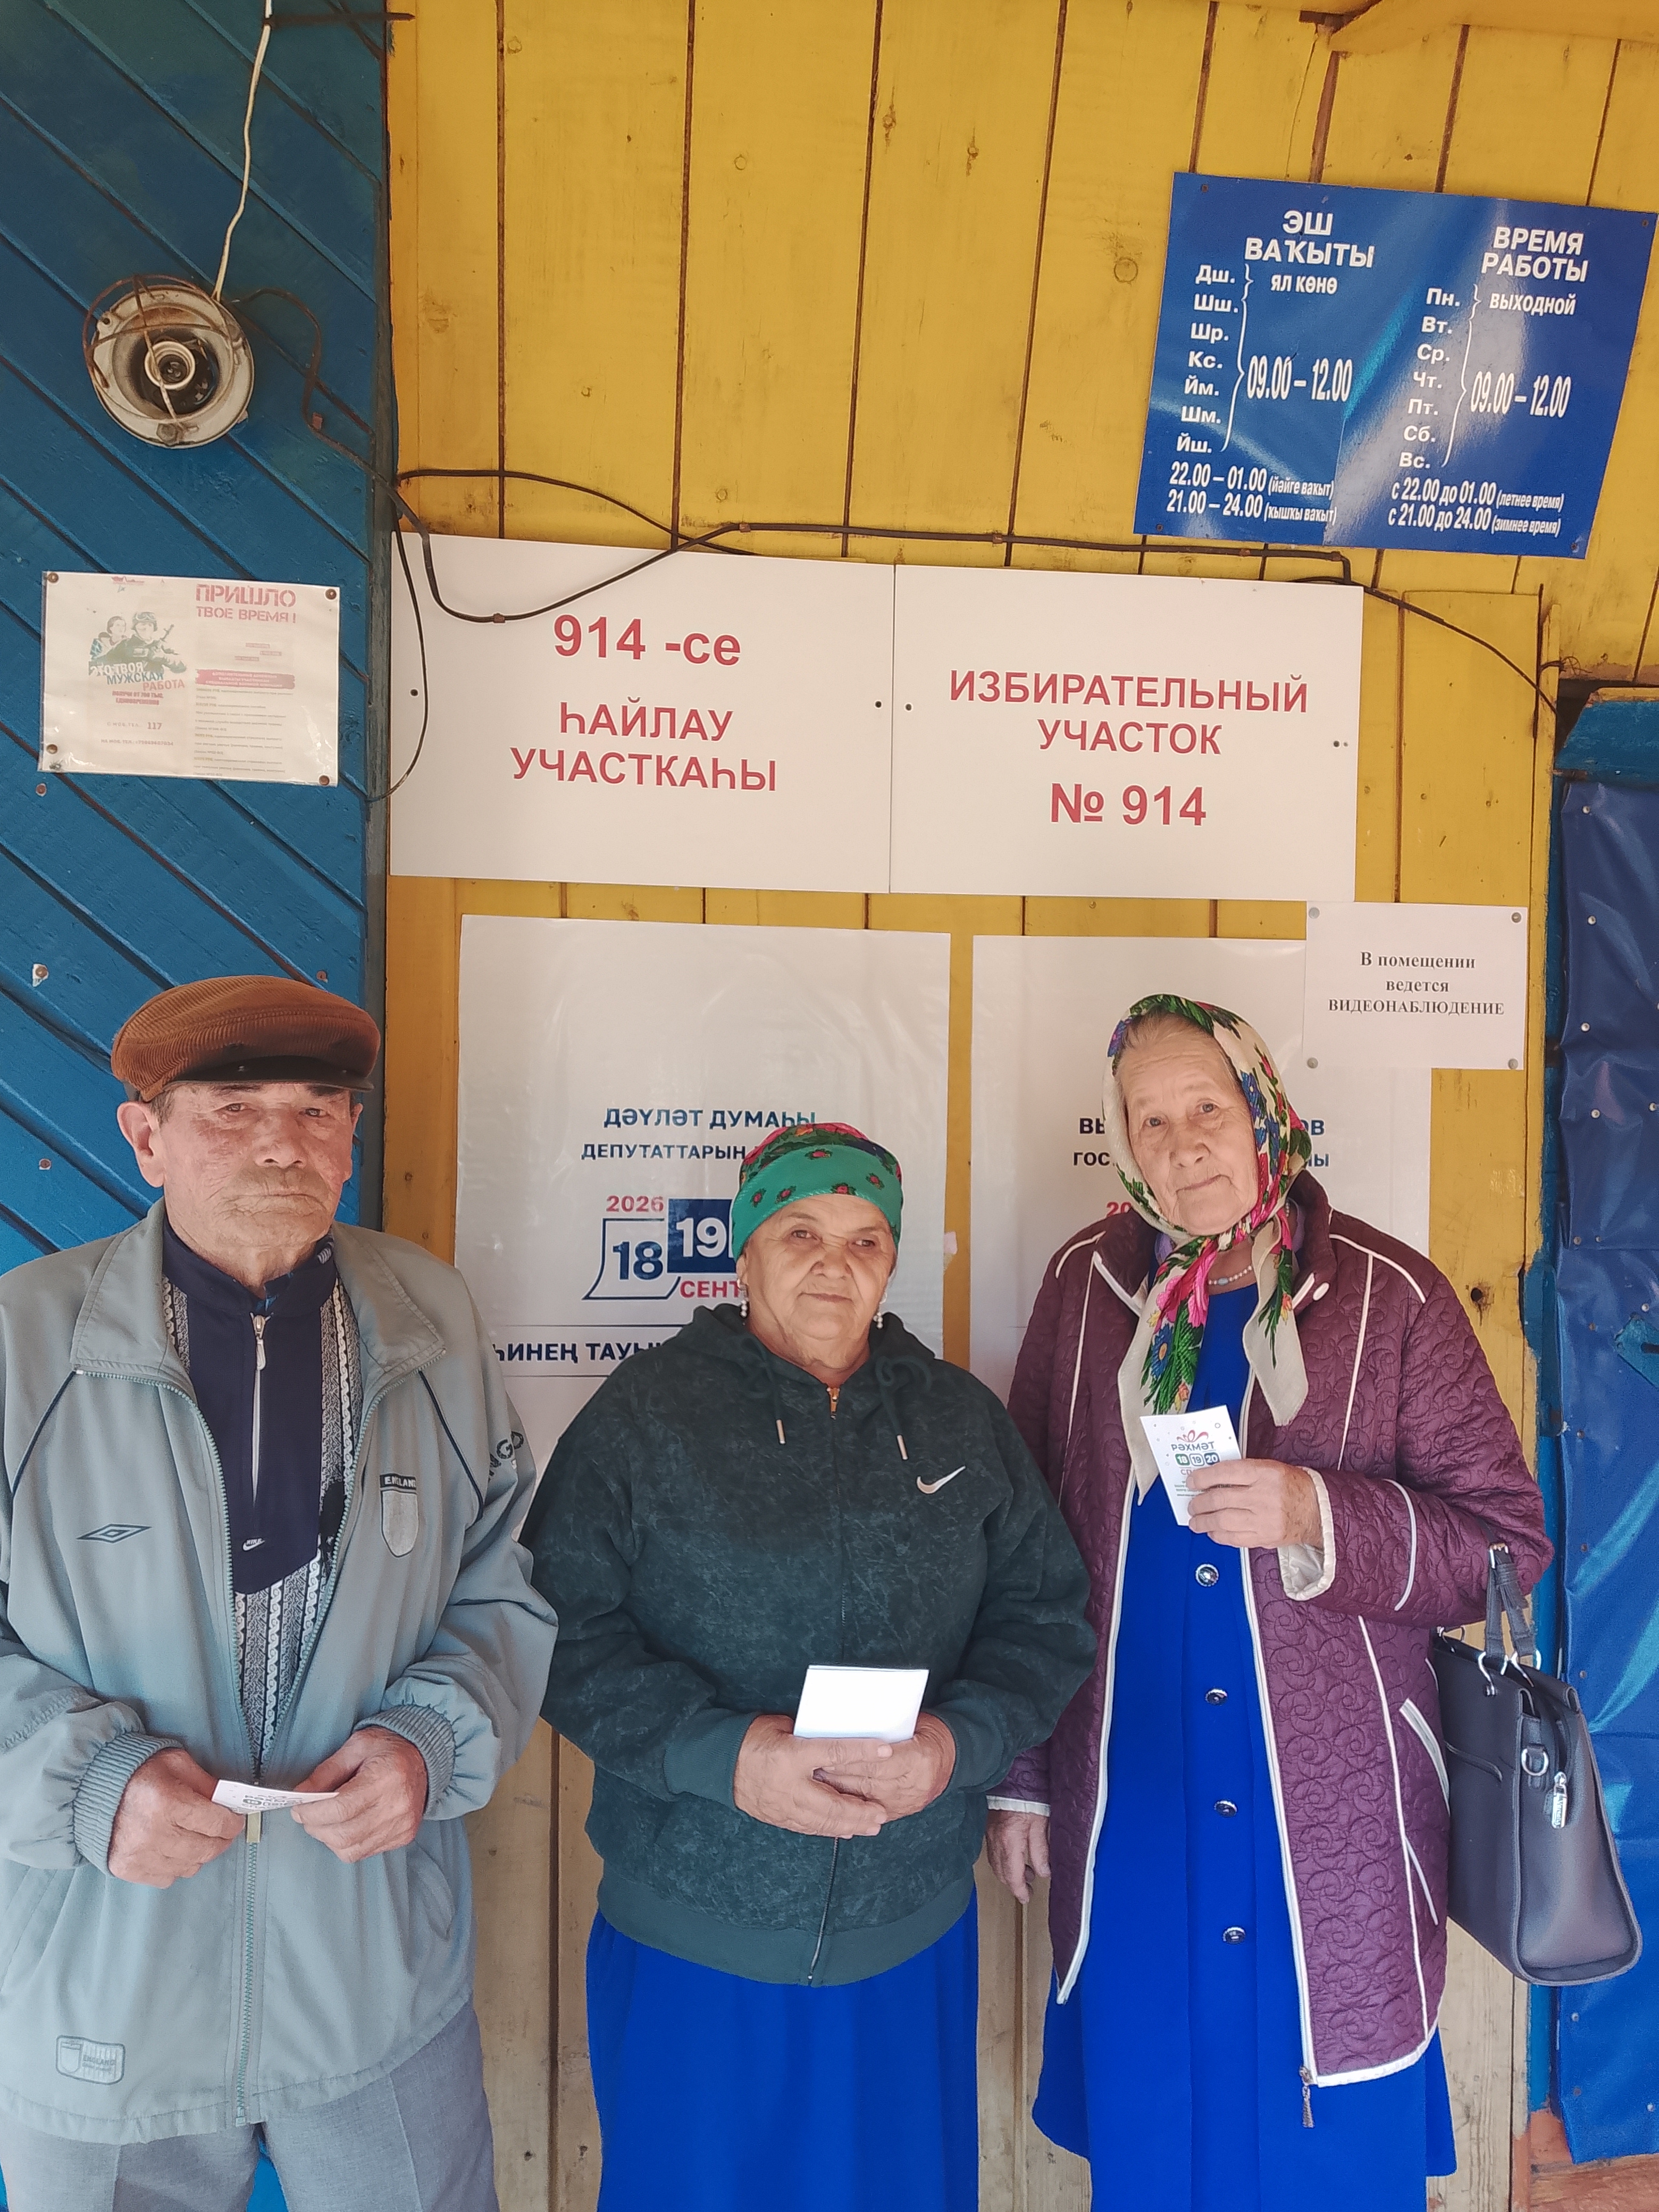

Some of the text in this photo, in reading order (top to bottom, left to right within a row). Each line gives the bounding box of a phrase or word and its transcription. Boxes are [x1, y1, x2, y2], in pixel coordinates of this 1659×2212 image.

[1283, 210, 1333, 236] ЭШ
[1493, 226, 1584, 255] ВРЕМЯ
[1195, 265, 1235, 285] Дш.
[1481, 253, 1589, 282] РАБОТЫ
[1194, 294, 1238, 313] Шш.
[1426, 288, 1460, 307] Пн.
[1191, 323, 1229, 343] Шр.
[1421, 316, 1452, 334] Вт.
[1188, 351, 1223, 369] Кс.
[1417, 343, 1449, 364] Ср.
[1184, 375, 1219, 396] Йм.
[1247, 355, 1292, 399] 09.00
[1311, 358, 1352, 401] 12.00
[1413, 372, 1442, 389] Чт.
[1471, 371, 1514, 414] 09.00
[1530, 375, 1571, 418] 12.00
[1181, 406, 1221, 423] Шм.
[1408, 399, 1438, 415] Пт.
[1176, 433, 1212, 453] Йш.
[1403, 425, 1435, 442] Сб.
[1399, 452, 1430, 468] Вс.
[1169, 461, 1211, 487] 22.00
[1227, 466, 1267, 492] 01.00
[1167, 489, 1206, 514] 21.00
[1223, 492, 1262, 518] 24.00
[1402, 477, 1440, 501] 22.00
[1439, 485, 1457, 506] до
[1460, 480, 1496, 506] 01.00
[1496, 489, 1531, 509] (летнее
[1532, 493, 1564, 513] время)
[1398, 502, 1436, 527] 21.00
[1434, 510, 1452, 532] до
[1454, 506, 1492, 531] 24.00
[1492, 515, 1528, 534] (зимнее
[1529, 518, 1561, 538] время)
[195, 583, 296, 607] ПРИШЛО
[196, 606, 233, 619] ТВОЕ
[238, 609, 288, 623] ВРЕМЯ
[553, 614, 742, 667] 914 -се
[90, 662, 144, 677] ЭТО ТВОЯ
[106, 672, 164, 685] МУЖСКАЯ
[143, 680, 186, 691] РАБОТА
[949, 669, 1308, 713] ИЗБИРАТЕЛЬНЫЙ
[559, 696, 733, 742] ҺАЙЛАУ
[1037, 718, 1222, 756] УЧАСТОК
[510, 747, 777, 792] УЧАСТКАҺЫ
[1050, 782, 1207, 826] № 914
[1360, 951, 1476, 969] В помещении
[1386, 979, 1449, 993] ведется
[1328, 999, 1505, 1017] ВИДЕОНАБЛЮДЕНИЕ
[604, 1108, 703, 1128] ДӘҮЛӘТ
[581, 1143, 746, 1160] ДЕПУТАТТАРЫН
[606, 1195, 664, 1213] 2026
[676, 1217, 727, 1258] 19
[613, 1241, 663, 1280] 18
[1177, 1455, 1188, 1464] 18
[1205, 1454, 1218, 1463] 20
